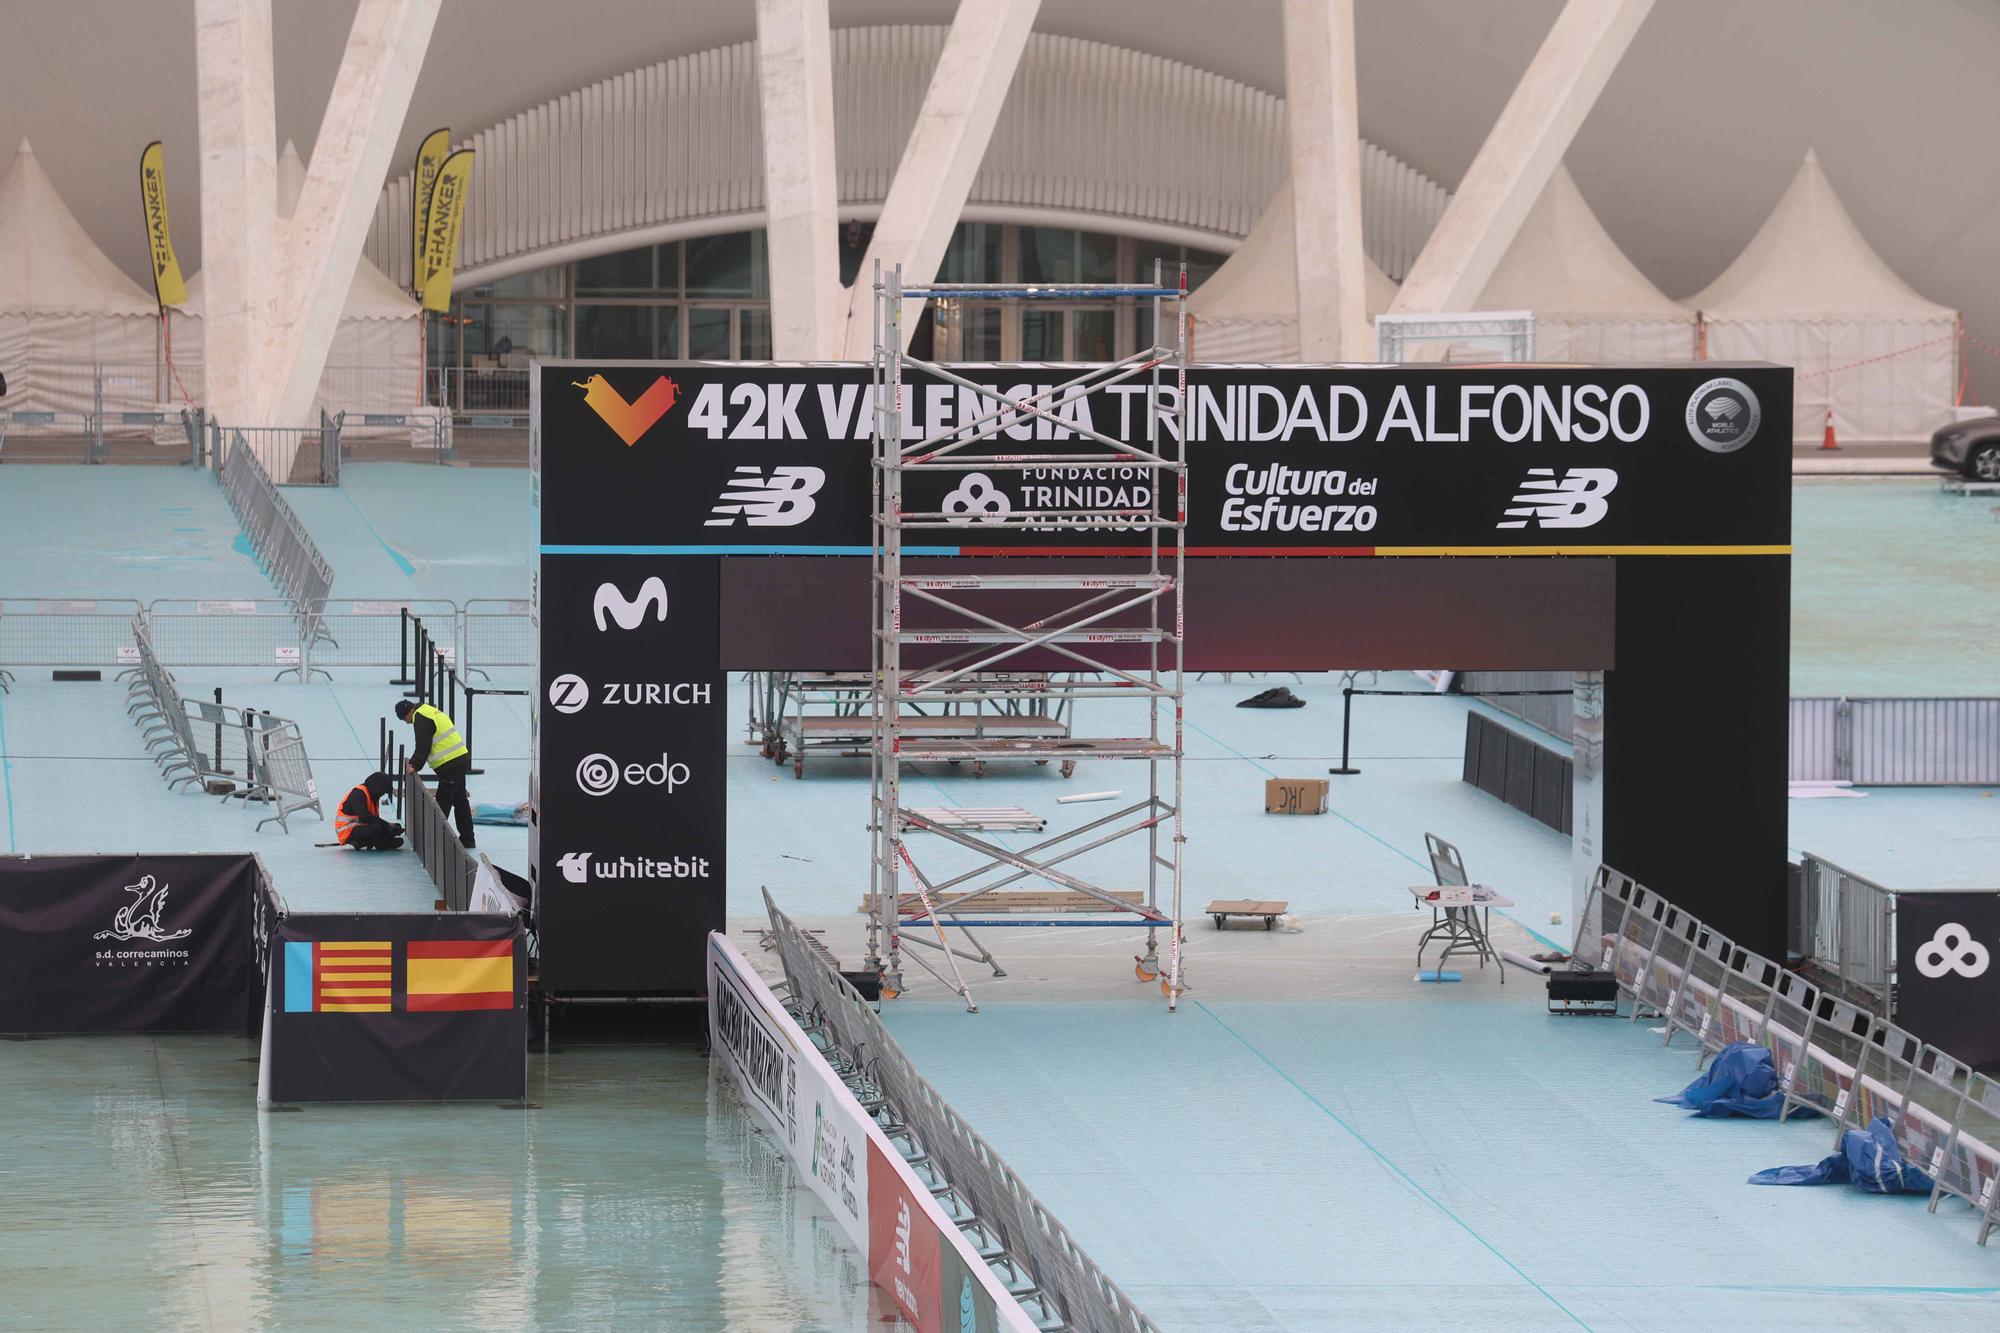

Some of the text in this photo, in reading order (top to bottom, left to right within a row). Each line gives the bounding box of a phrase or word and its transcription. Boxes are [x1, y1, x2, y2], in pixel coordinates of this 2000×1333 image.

[431, 174, 458, 256] HANKER
[687, 383, 1650, 443] 42K VALENCIA TRINIDAD ALFONSO
[1225, 463, 1377, 496] Cultura del
[1020, 486, 1151, 507] TRINIDAD
[1220, 498, 1378, 532] Esfuerzo
[602, 683, 711, 705] ZURICH
[624, 752, 690, 794] edp
[595, 856, 709, 878] whitebit
[95, 948, 189, 959] s.d. correcaminos
